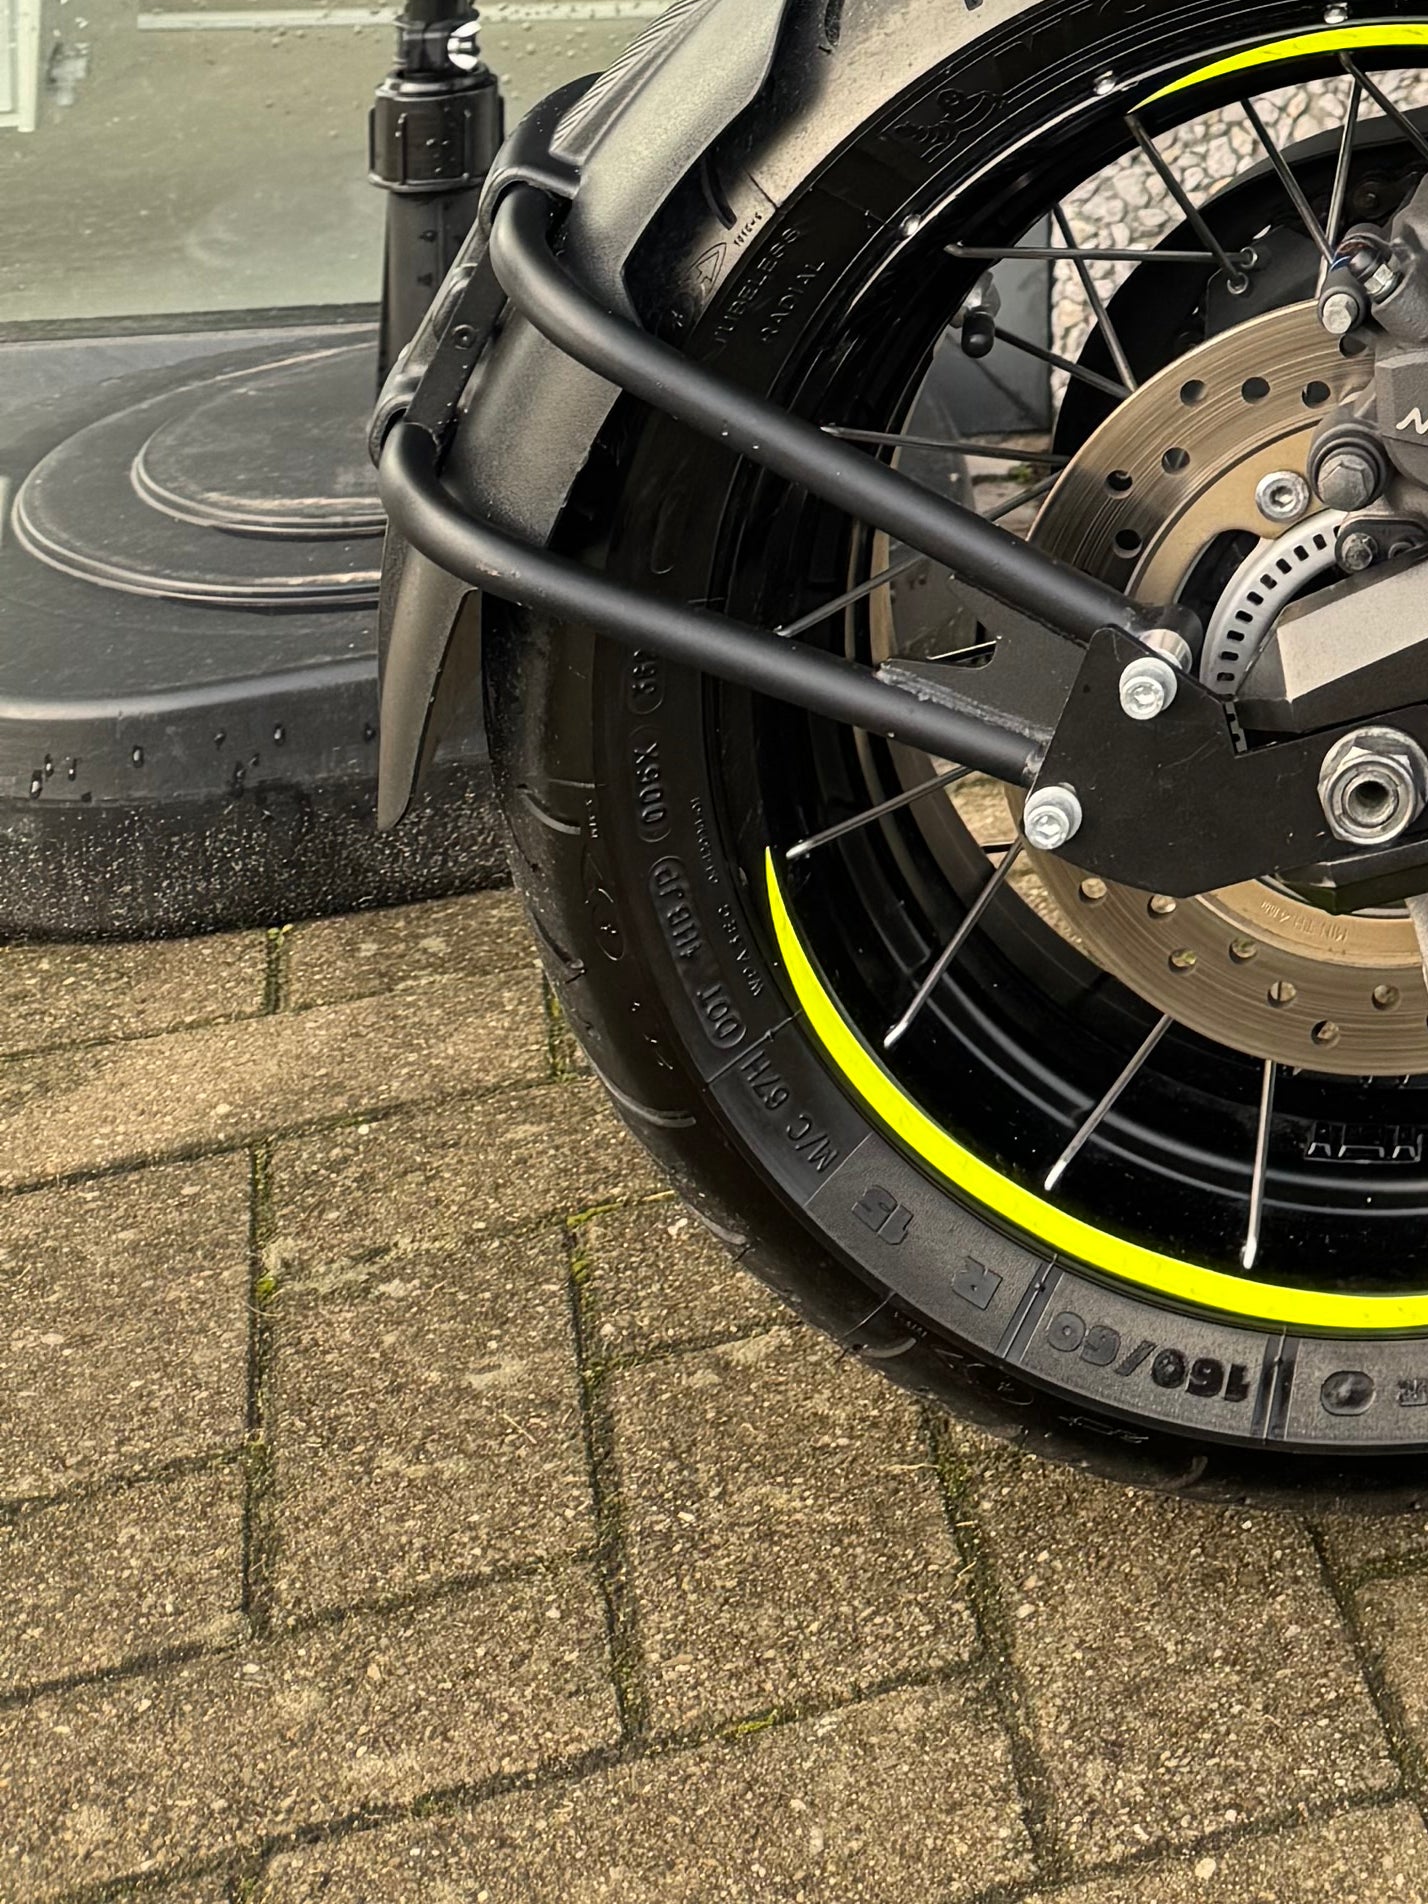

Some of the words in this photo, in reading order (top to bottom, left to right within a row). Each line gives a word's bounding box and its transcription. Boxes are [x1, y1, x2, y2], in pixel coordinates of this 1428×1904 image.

[739, 1049, 791, 1114] 67H
[785, 1110, 840, 1176] M/C
[851, 1184, 915, 1246] 15
[951, 1254, 1004, 1311] R
[1044, 1309, 1250, 1404] 160/60
